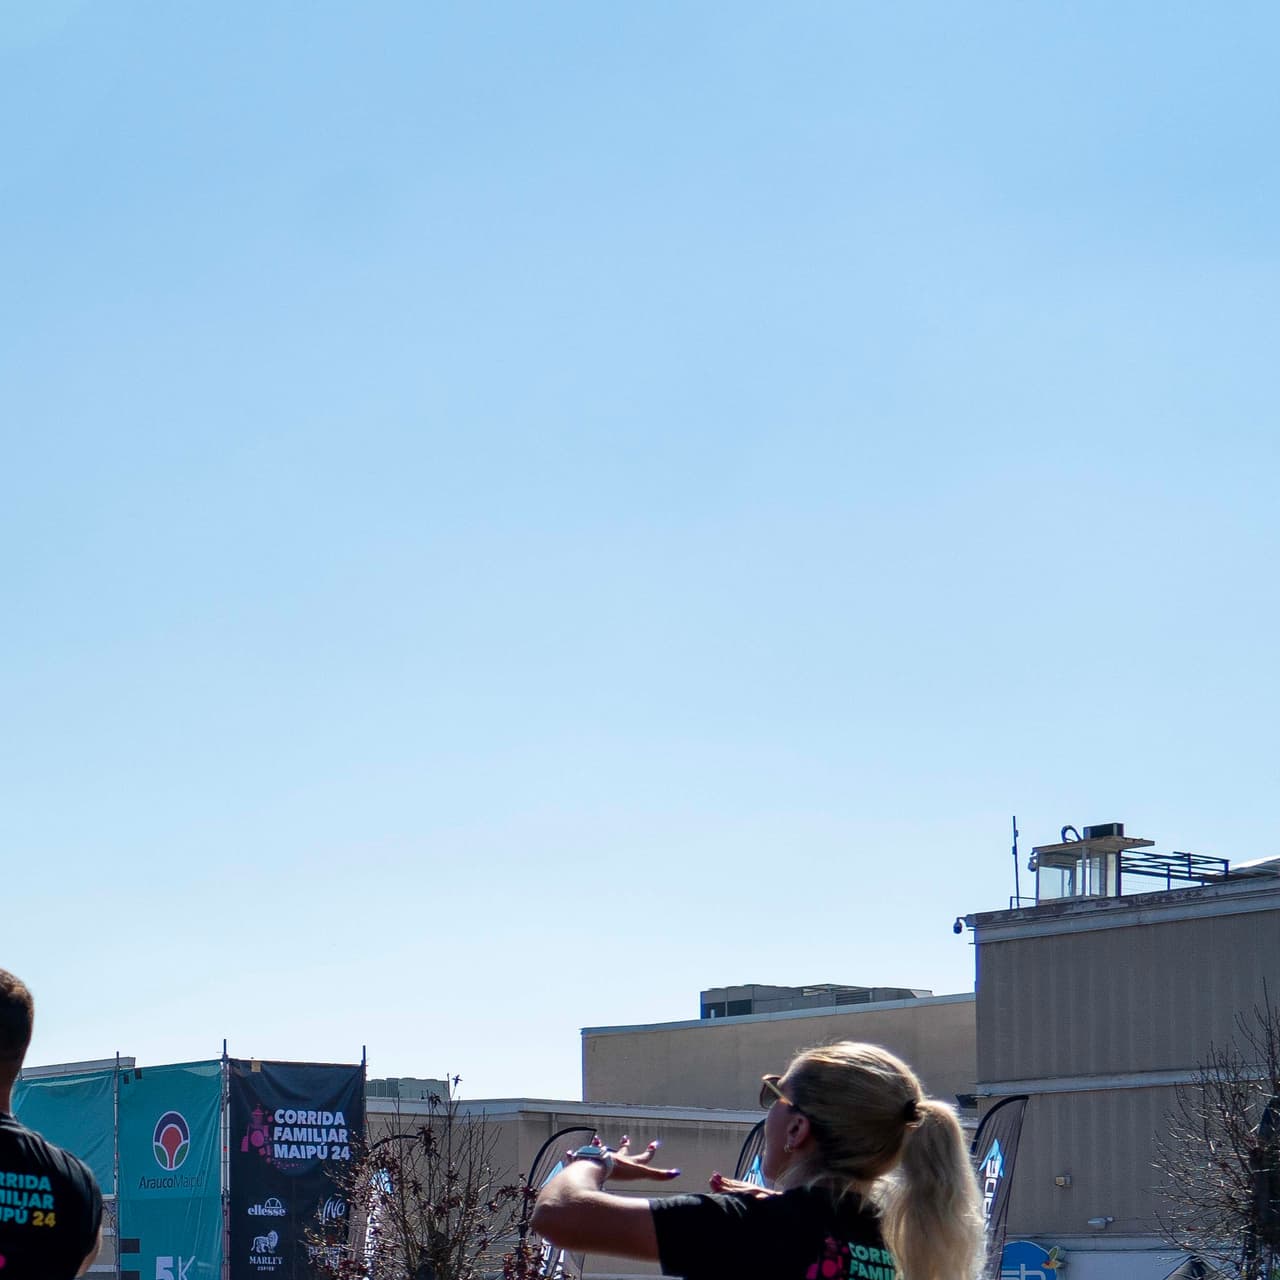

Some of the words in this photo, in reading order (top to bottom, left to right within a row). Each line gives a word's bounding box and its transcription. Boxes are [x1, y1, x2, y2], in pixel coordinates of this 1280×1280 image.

[273, 1108, 346, 1127] CORRIDA
[273, 1126, 348, 1144] FAMILIAR
[273, 1142, 329, 1160] MAIPÚ
[331, 1145, 351, 1161] 24
[32, 1210, 57, 1228] 24
[247, 1204, 287, 1217] ellesse
[249, 1256, 283, 1265] MARLEY
